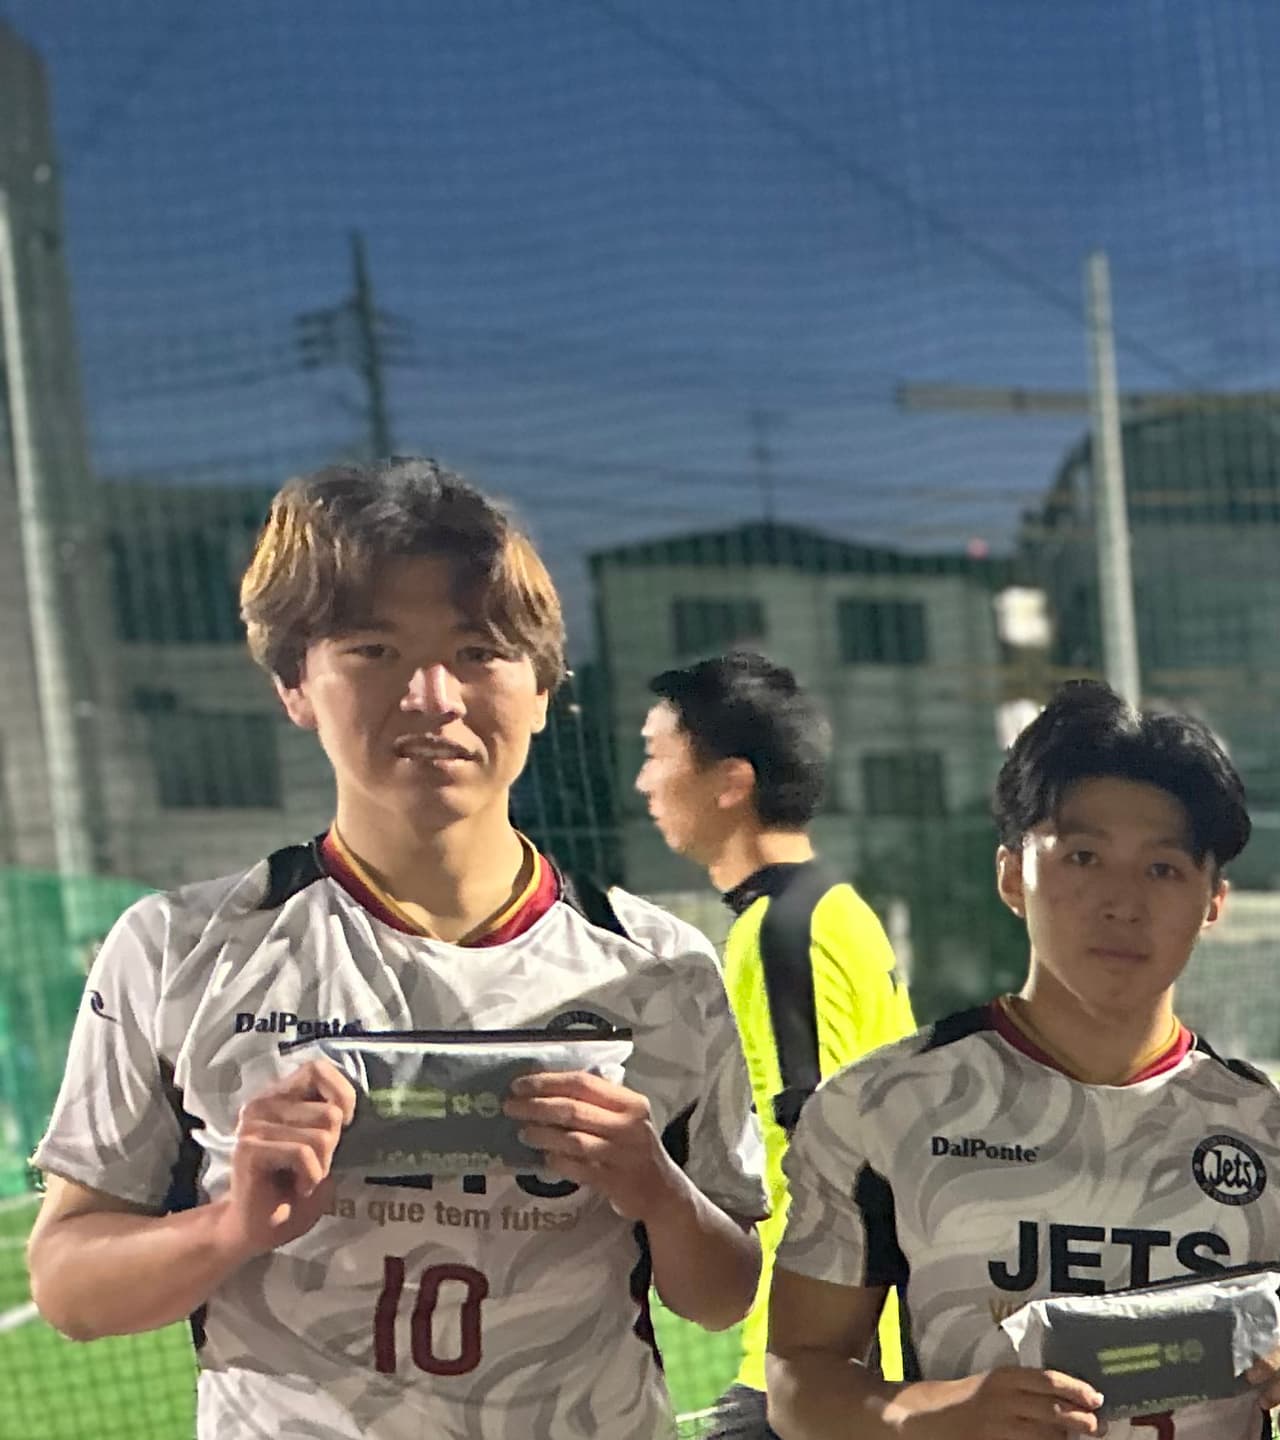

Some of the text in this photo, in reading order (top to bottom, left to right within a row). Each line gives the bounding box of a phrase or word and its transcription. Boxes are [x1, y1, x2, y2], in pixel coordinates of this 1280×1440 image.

[931, 1136, 1037, 1163] DalPonte
[1207, 1149, 1253, 1189] Jets
[367, 1201, 425, 1227] que
[434, 1205, 490, 1230] tem
[987, 1220, 1231, 1295] JETS
[373, 1255, 489, 1376] 10
